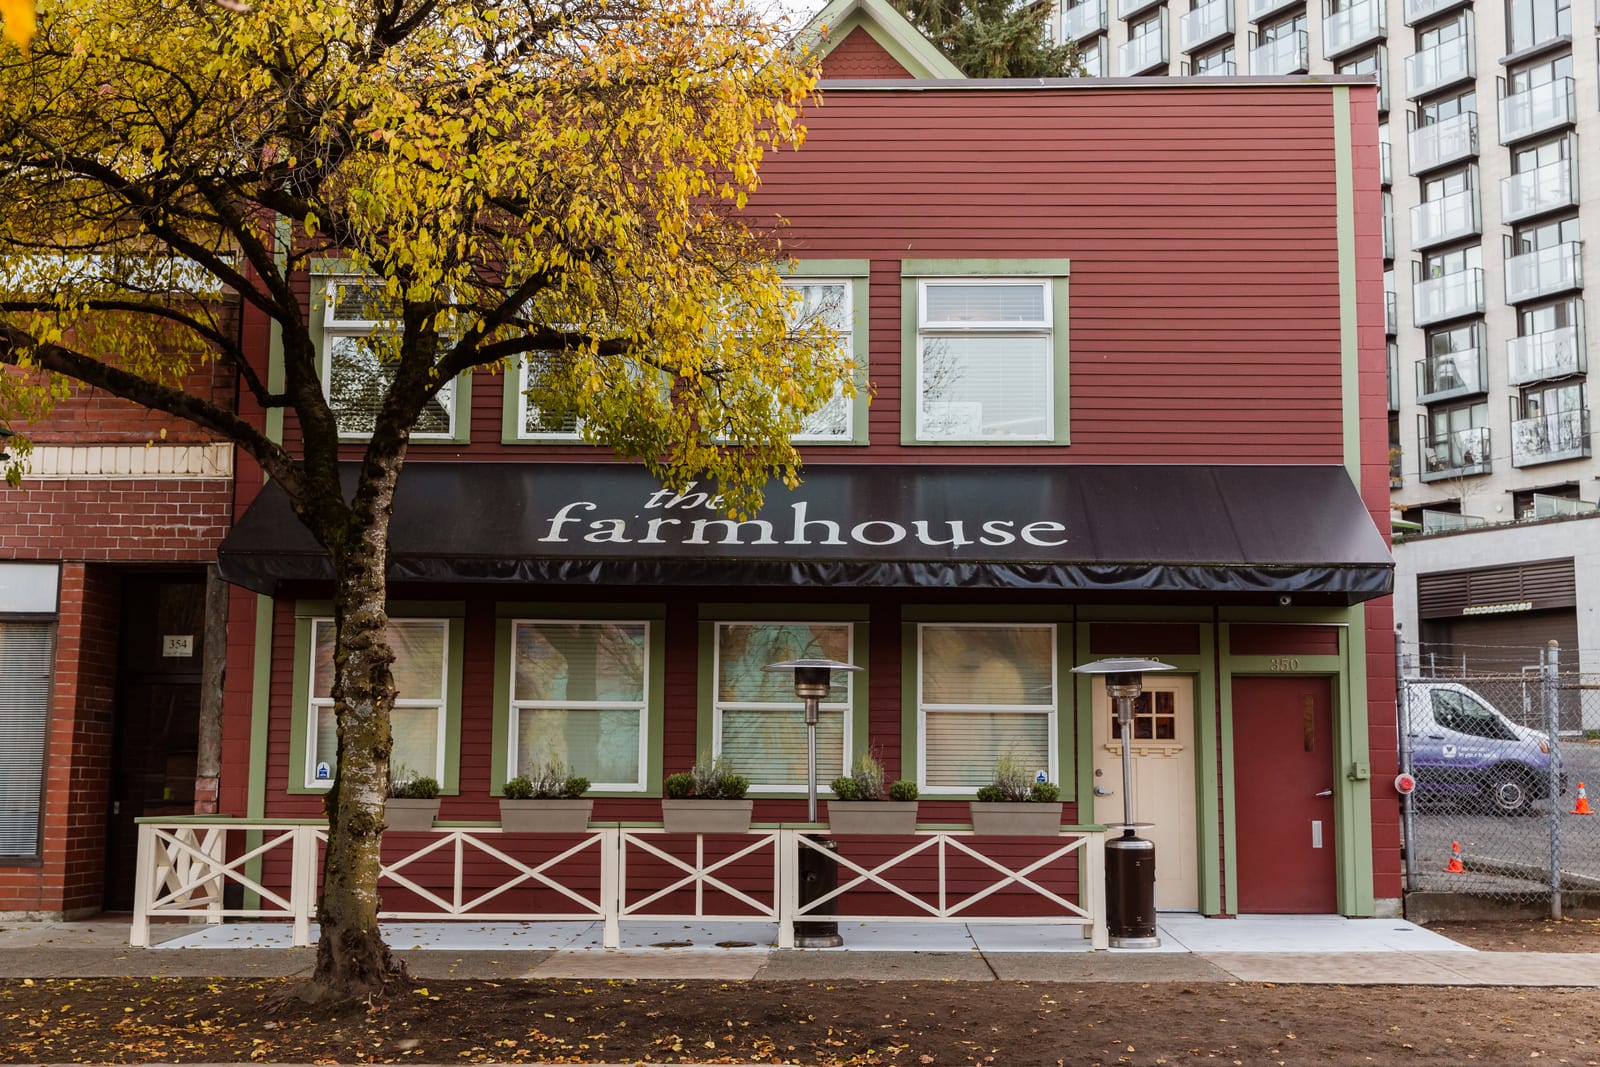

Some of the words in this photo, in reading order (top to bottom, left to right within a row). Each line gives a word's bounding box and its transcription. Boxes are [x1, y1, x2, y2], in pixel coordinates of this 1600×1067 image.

[644, 481, 724, 510] the
[537, 501, 1068, 547] farmhouse
[169, 639, 187, 649] 354
[1270, 657, 1300, 671] 350
